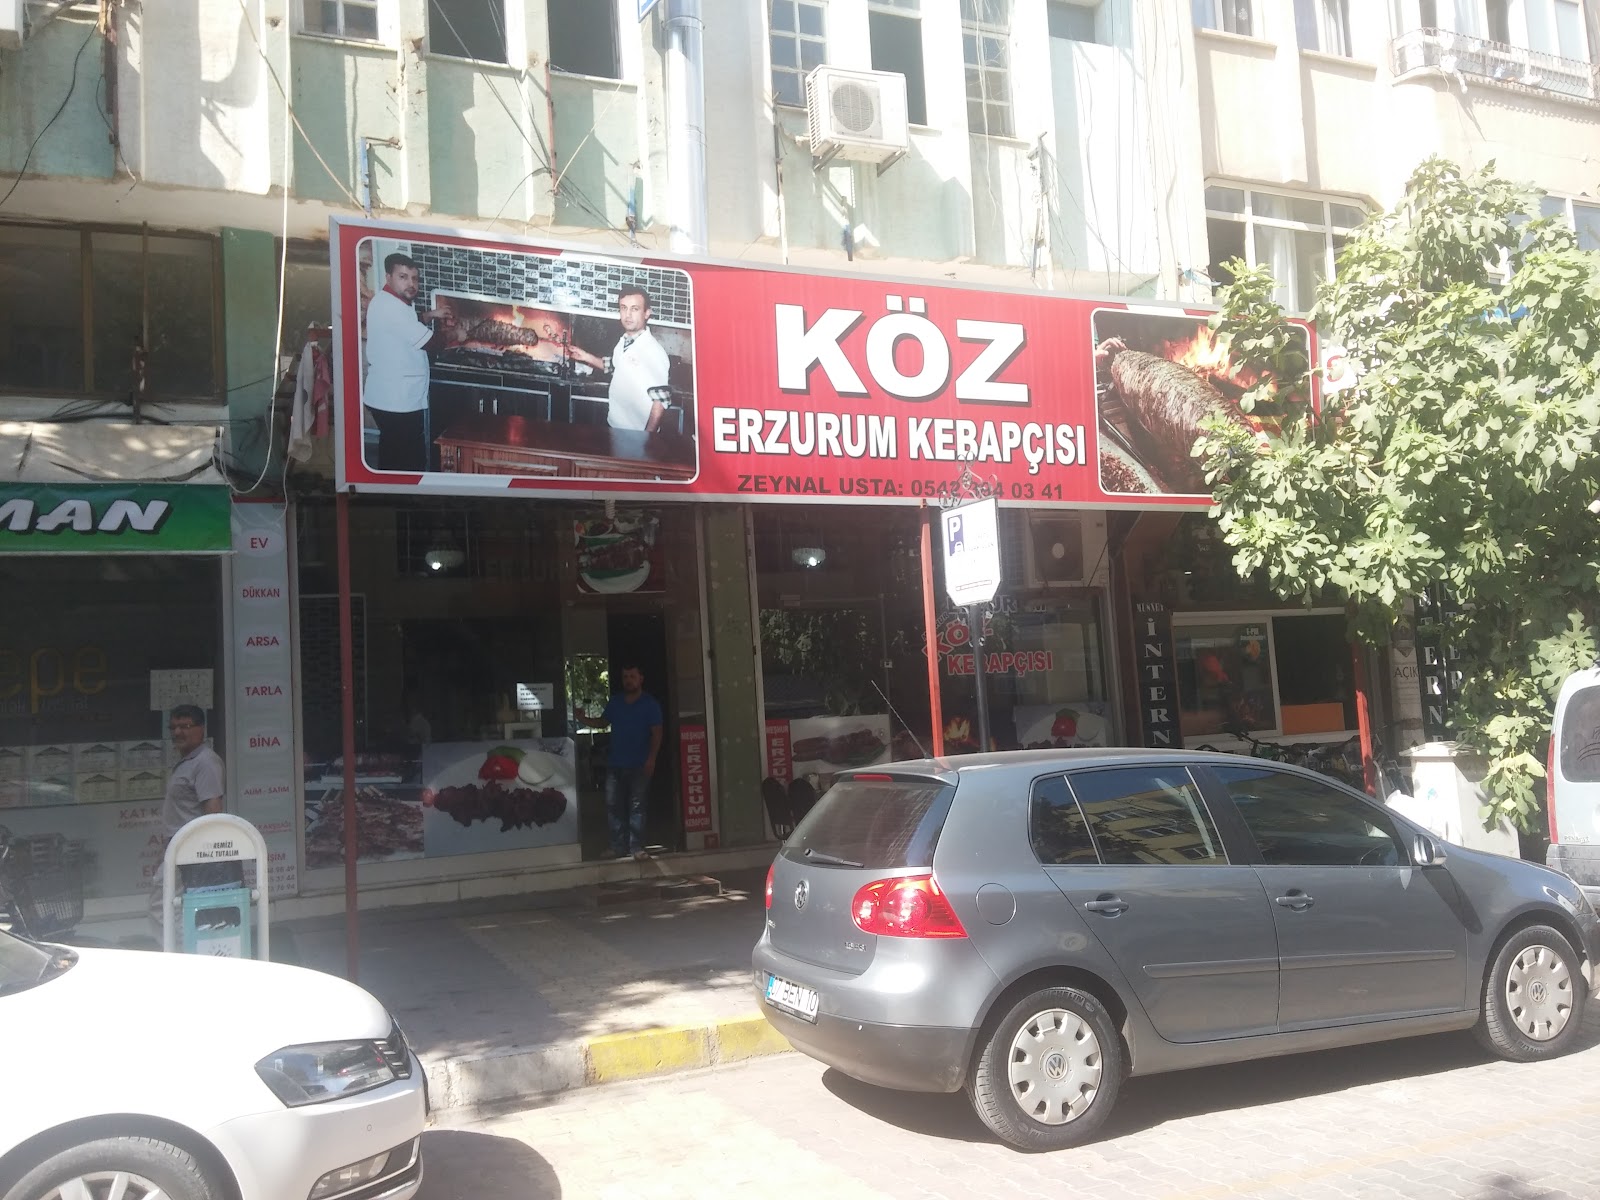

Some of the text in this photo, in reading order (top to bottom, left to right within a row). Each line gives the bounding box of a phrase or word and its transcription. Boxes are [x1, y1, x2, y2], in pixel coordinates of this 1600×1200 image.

[775, 294, 1030, 405] KÖZ
[712, 405, 1087, 475] ERZURUM KEBAPÇISI
[737, 474, 831, 494] ZEYNAL
[839, 477, 903, 496] USTA:
[911, 479, 961, 498] 0542
[1011, 482, 1035, 499] 03
[1041, 484, 1063, 500] 41
[949, 516, 961, 541] P
[250, 537, 269, 549] EV
[242, 586, 280, 598] DÜKKAN
[246, 636, 280, 647] ARSA
[1393, 666, 1418, 680] AÇIK
[245, 686, 282, 697] TARLA
[250, 734, 281, 748] BİNA
[687, 744, 706, 815] ERZURUM
